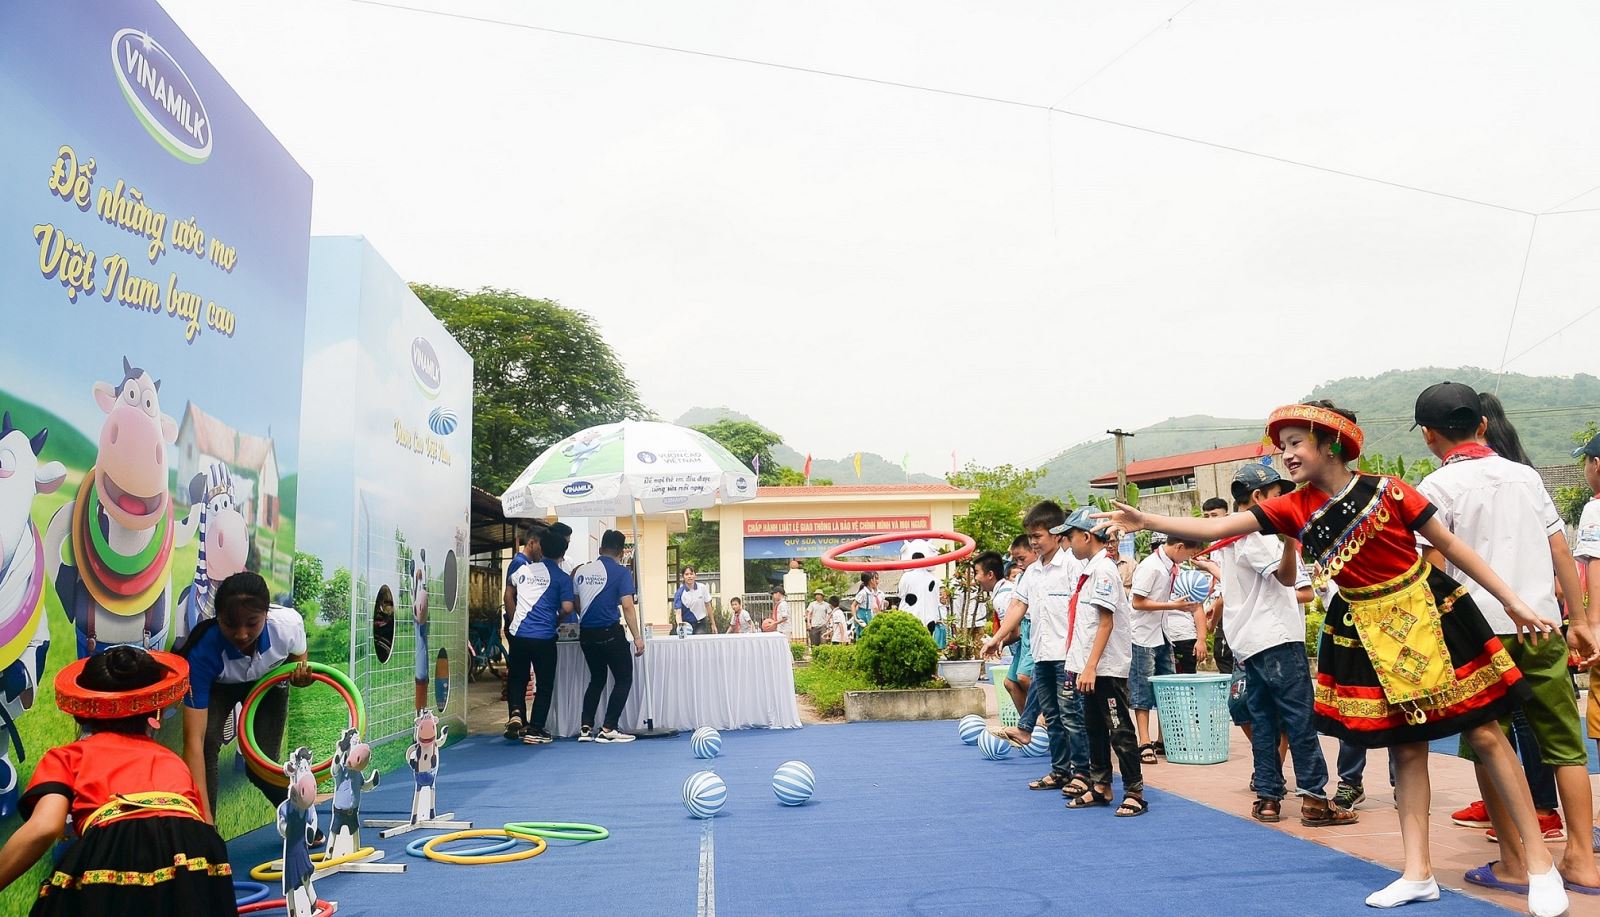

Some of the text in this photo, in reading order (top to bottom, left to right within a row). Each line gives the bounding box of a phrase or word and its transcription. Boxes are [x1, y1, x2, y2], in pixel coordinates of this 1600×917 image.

[125, 39, 205, 145] VINAMILK
[48, 144, 238, 273] Để những ước mơ
[32, 222, 236, 344] Việt Nam bay cao
[412, 342, 441, 386] VINAMILK
[563, 484, 593, 495] VINAMILK
[779, 521, 792, 534] LUẬT
[792, 521, 800, 533] LỆ
[800, 522, 813, 532] GIAO
[814, 520, 832, 531] THÔNG
[832, 519, 840, 531] LÀ
[851, 519, 859, 531] VỆ
[784, 537, 800, 546] QUỸ
[801, 537, 816, 545] SỮA
